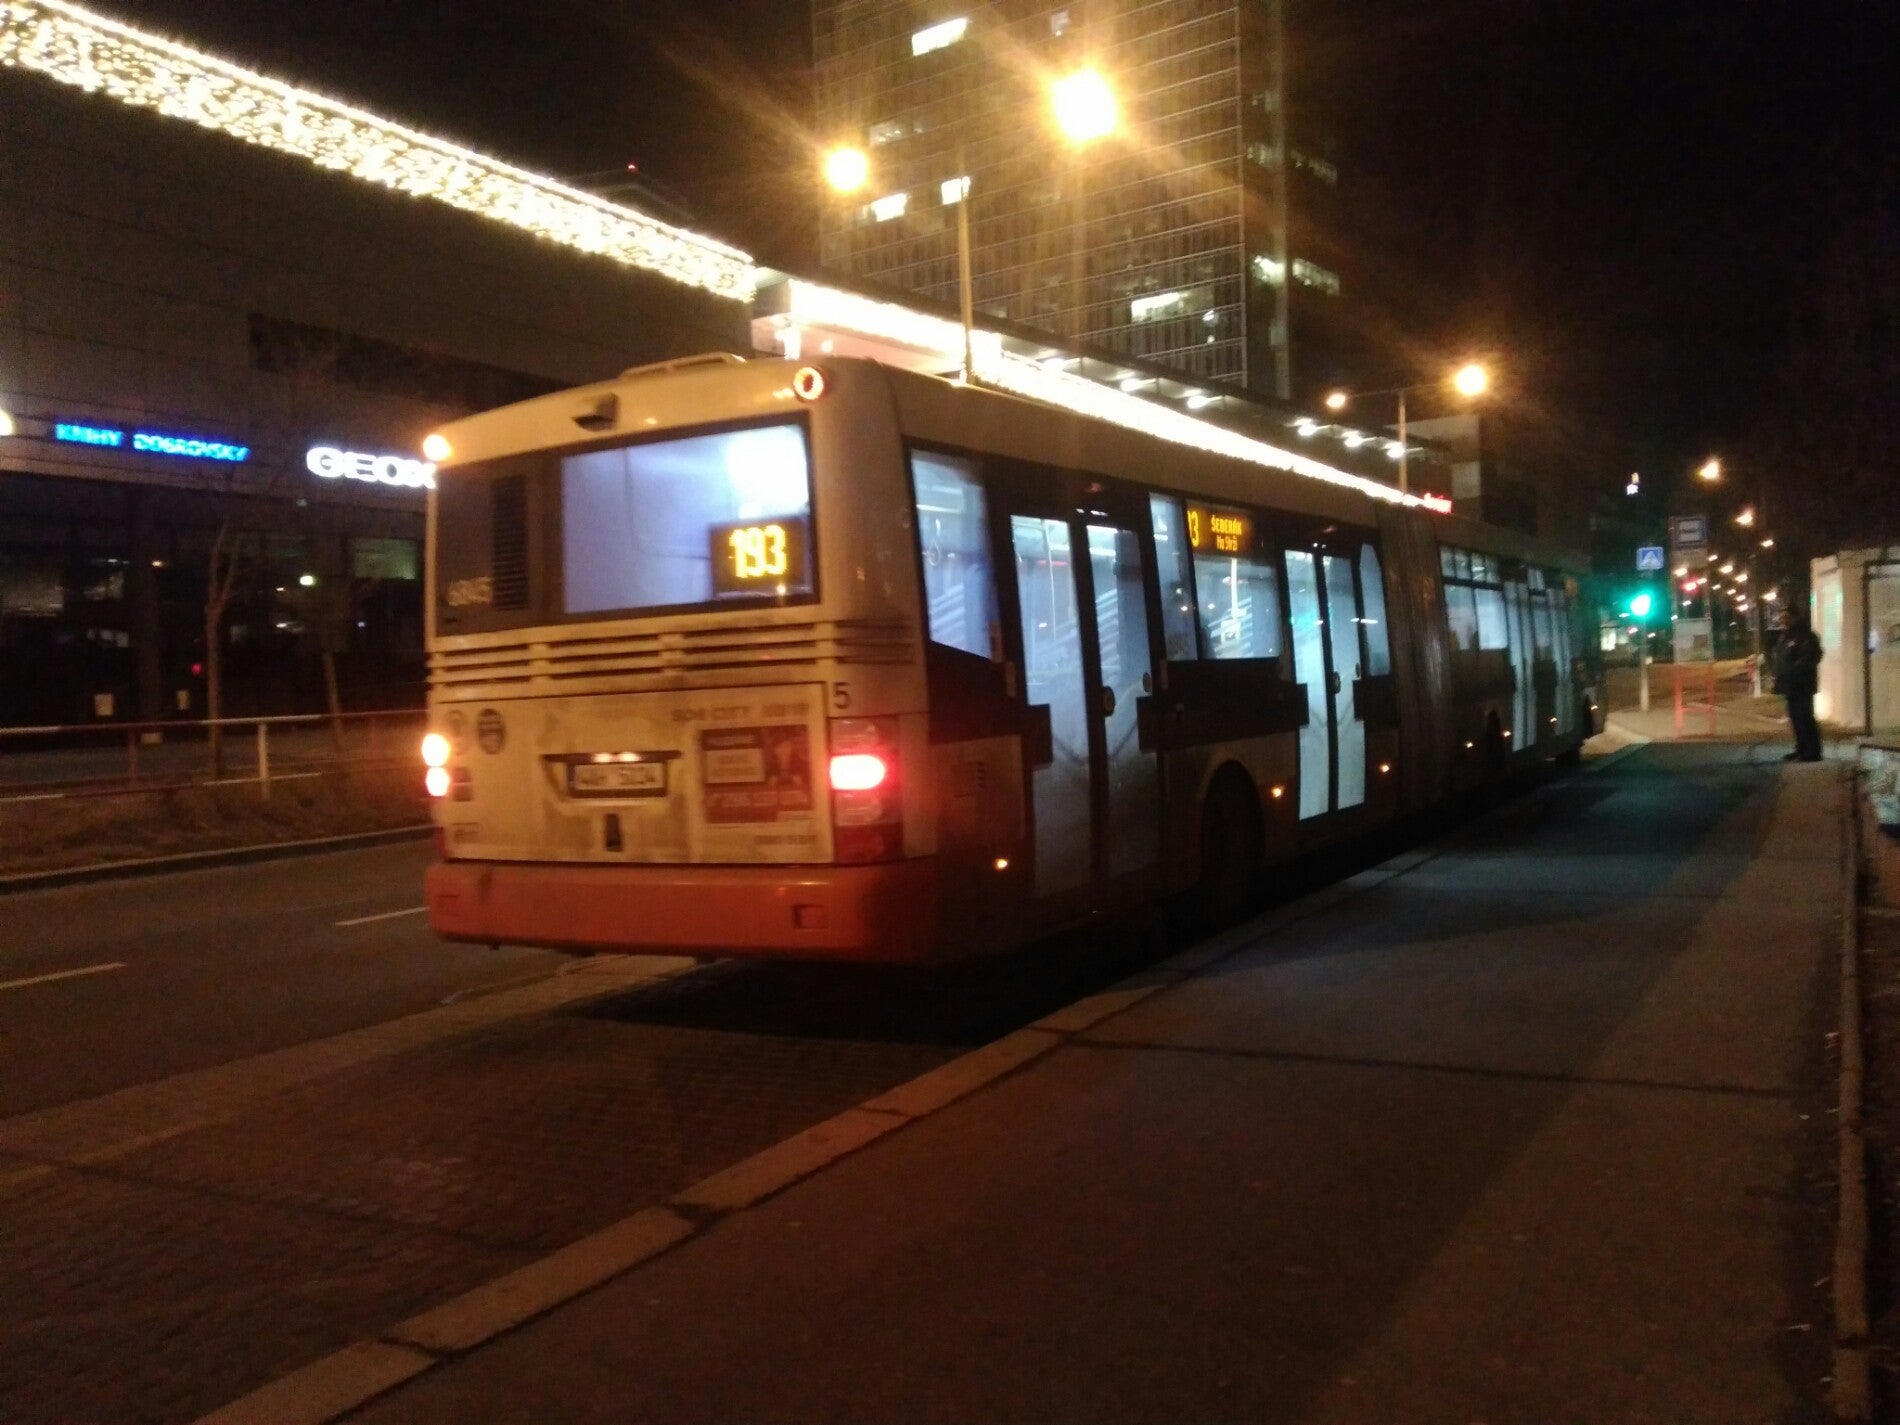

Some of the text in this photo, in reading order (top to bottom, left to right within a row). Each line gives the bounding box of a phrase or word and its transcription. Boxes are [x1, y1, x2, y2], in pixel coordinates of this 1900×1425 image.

[306, 446, 437, 490] GEOX
[728, 524, 787, 579] 193
[834, 681, 850, 709] 5
